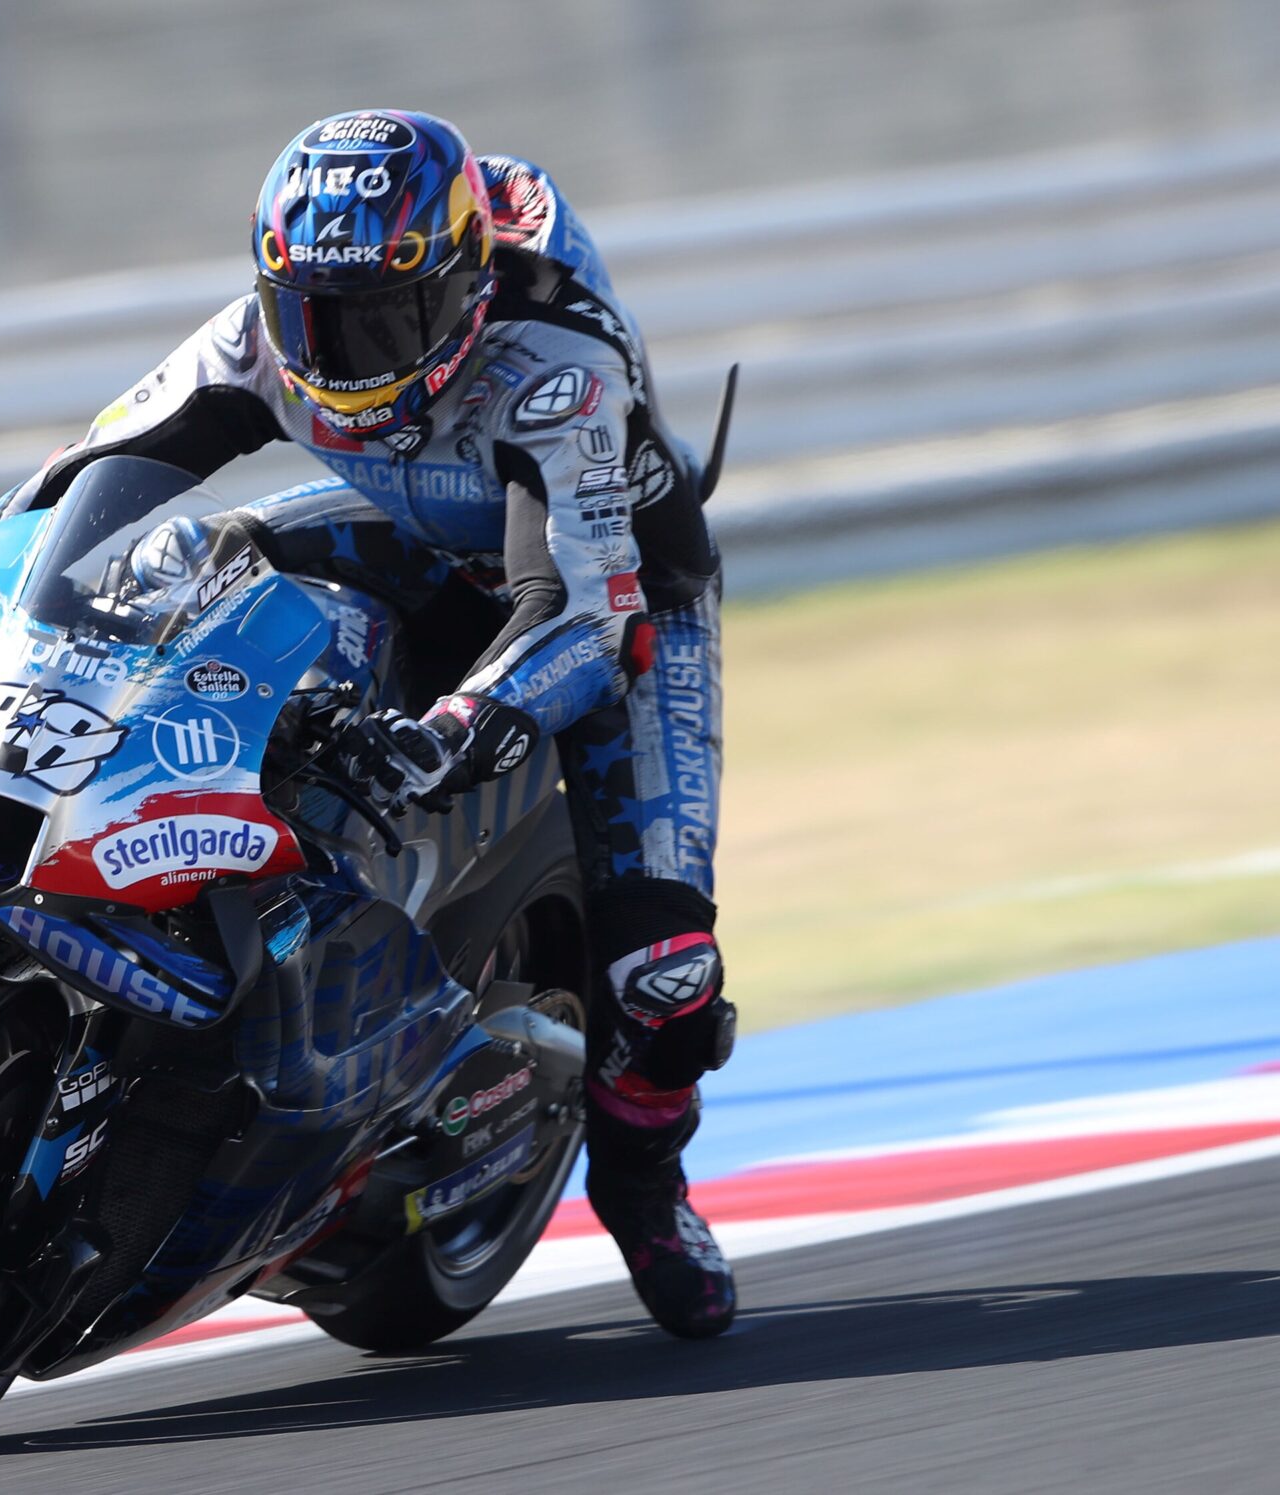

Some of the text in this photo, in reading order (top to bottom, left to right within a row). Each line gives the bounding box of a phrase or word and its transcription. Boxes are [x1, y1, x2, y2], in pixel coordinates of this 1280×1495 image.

[288, 244, 384, 264] SHARK
[328, 371, 397, 391] HYUNDAI
[323, 454, 507, 504] RACKHOUSE
[201, 545, 252, 610] WRS
[20, 629, 129, 687] prilia
[193, 671, 240, 683] Estrella
[501, 634, 604, 706] RACKHOUSE
[197, 681, 240, 692] Galicia
[664, 643, 712, 870] TRACKHOUSE
[103, 821, 266, 876] sterilgarda
[160, 868, 217, 886] alimenti
[8, 906, 207, 1027] HOUSE
[62, 1117, 109, 1171] SC
